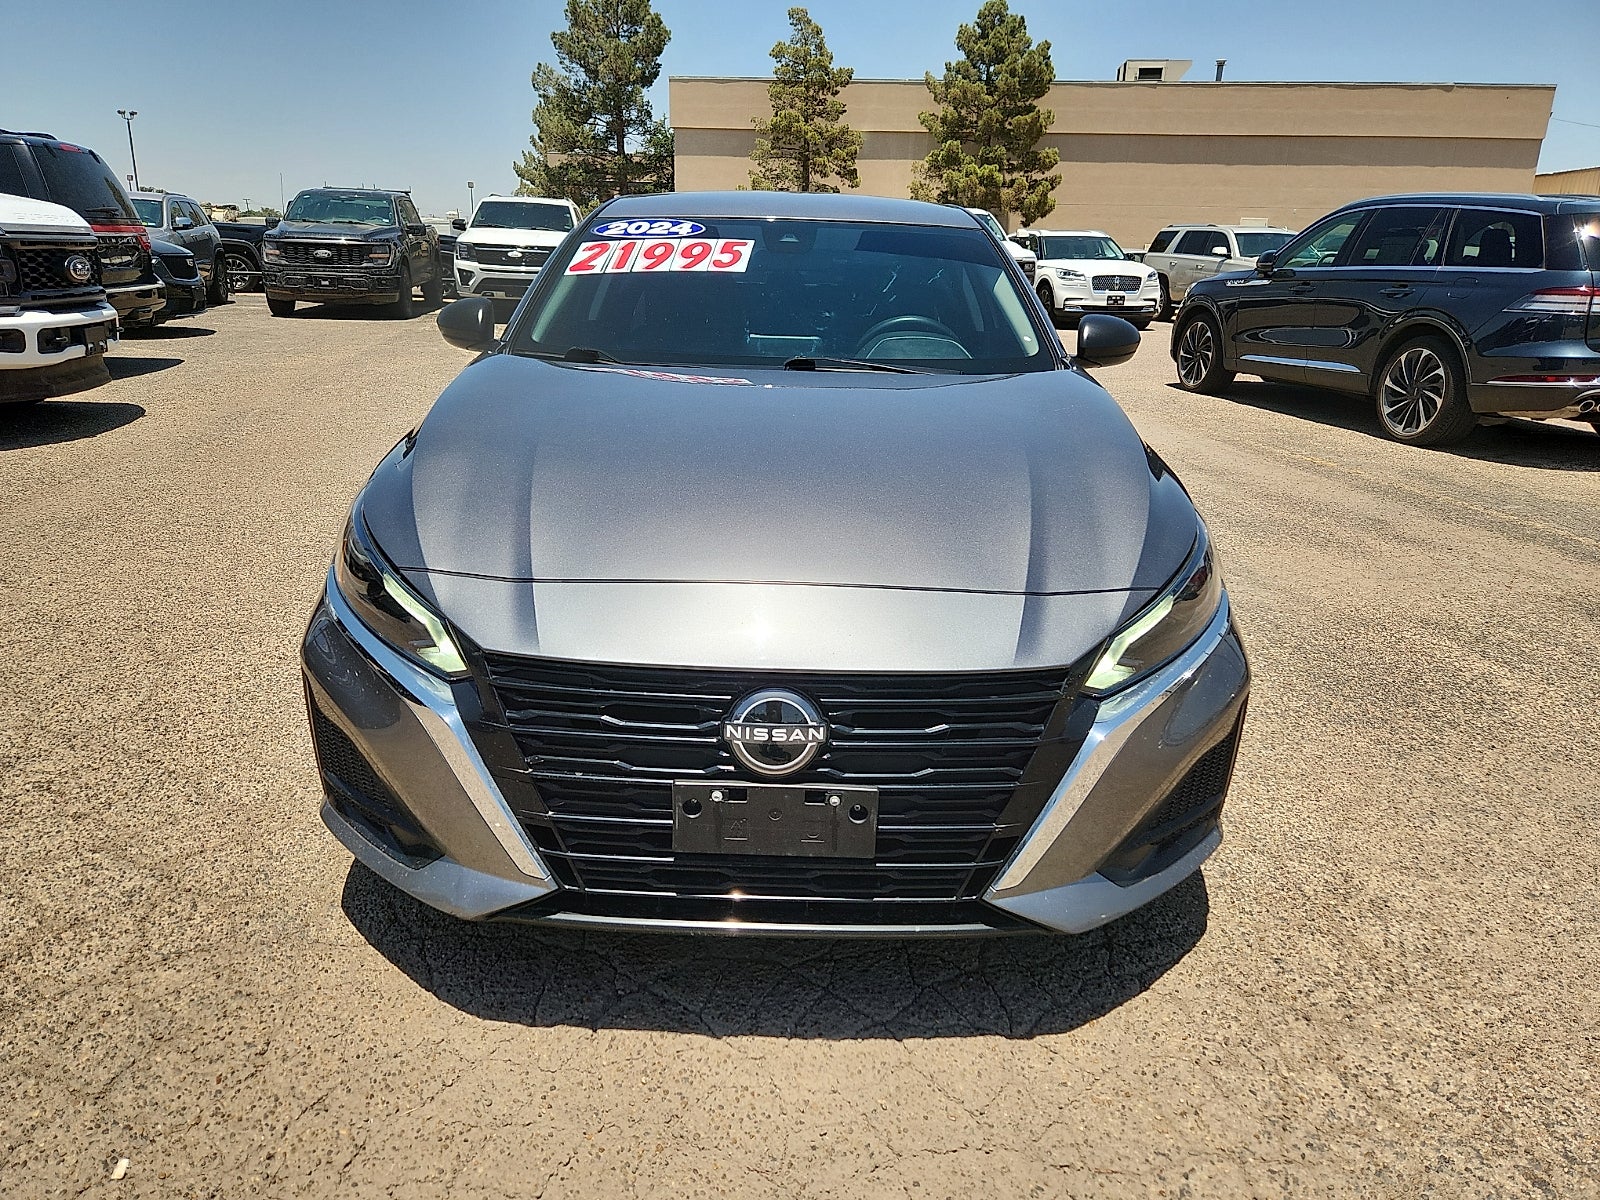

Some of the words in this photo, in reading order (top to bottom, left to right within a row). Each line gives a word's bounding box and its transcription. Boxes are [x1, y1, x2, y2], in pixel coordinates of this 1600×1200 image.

[606, 221, 693, 236] 2024
[569, 241, 748, 272] 21995
[726, 724, 824, 742] NISSAN
